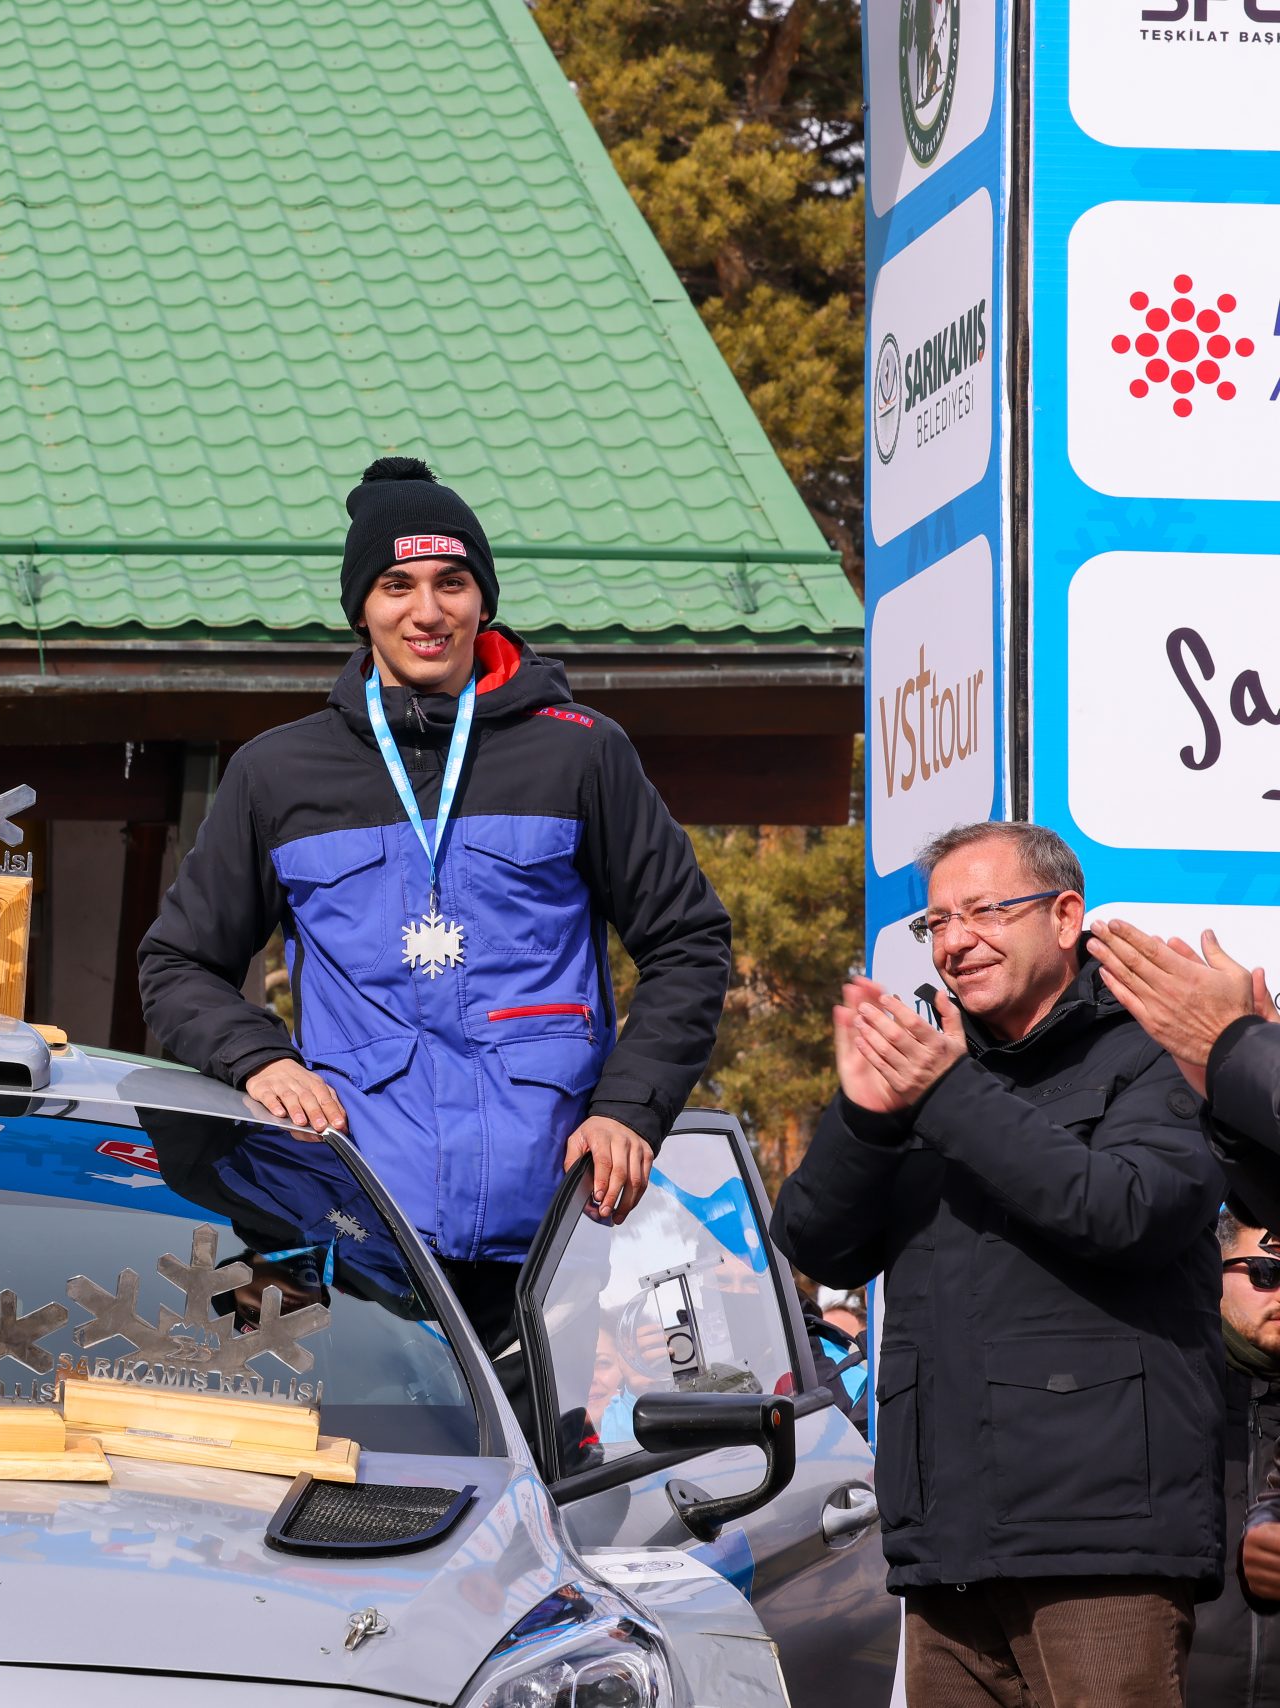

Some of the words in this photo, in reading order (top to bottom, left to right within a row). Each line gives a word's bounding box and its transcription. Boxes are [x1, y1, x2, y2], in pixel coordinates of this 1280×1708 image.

[1140, 29, 1230, 42] TEŞKİLAT
[1239, 31, 1280, 45] BAŞ
[904, 298, 986, 413] SARIKAMIŞ
[916, 375, 974, 449] BELEDİYESİ
[398, 537, 465, 558] PCRS
